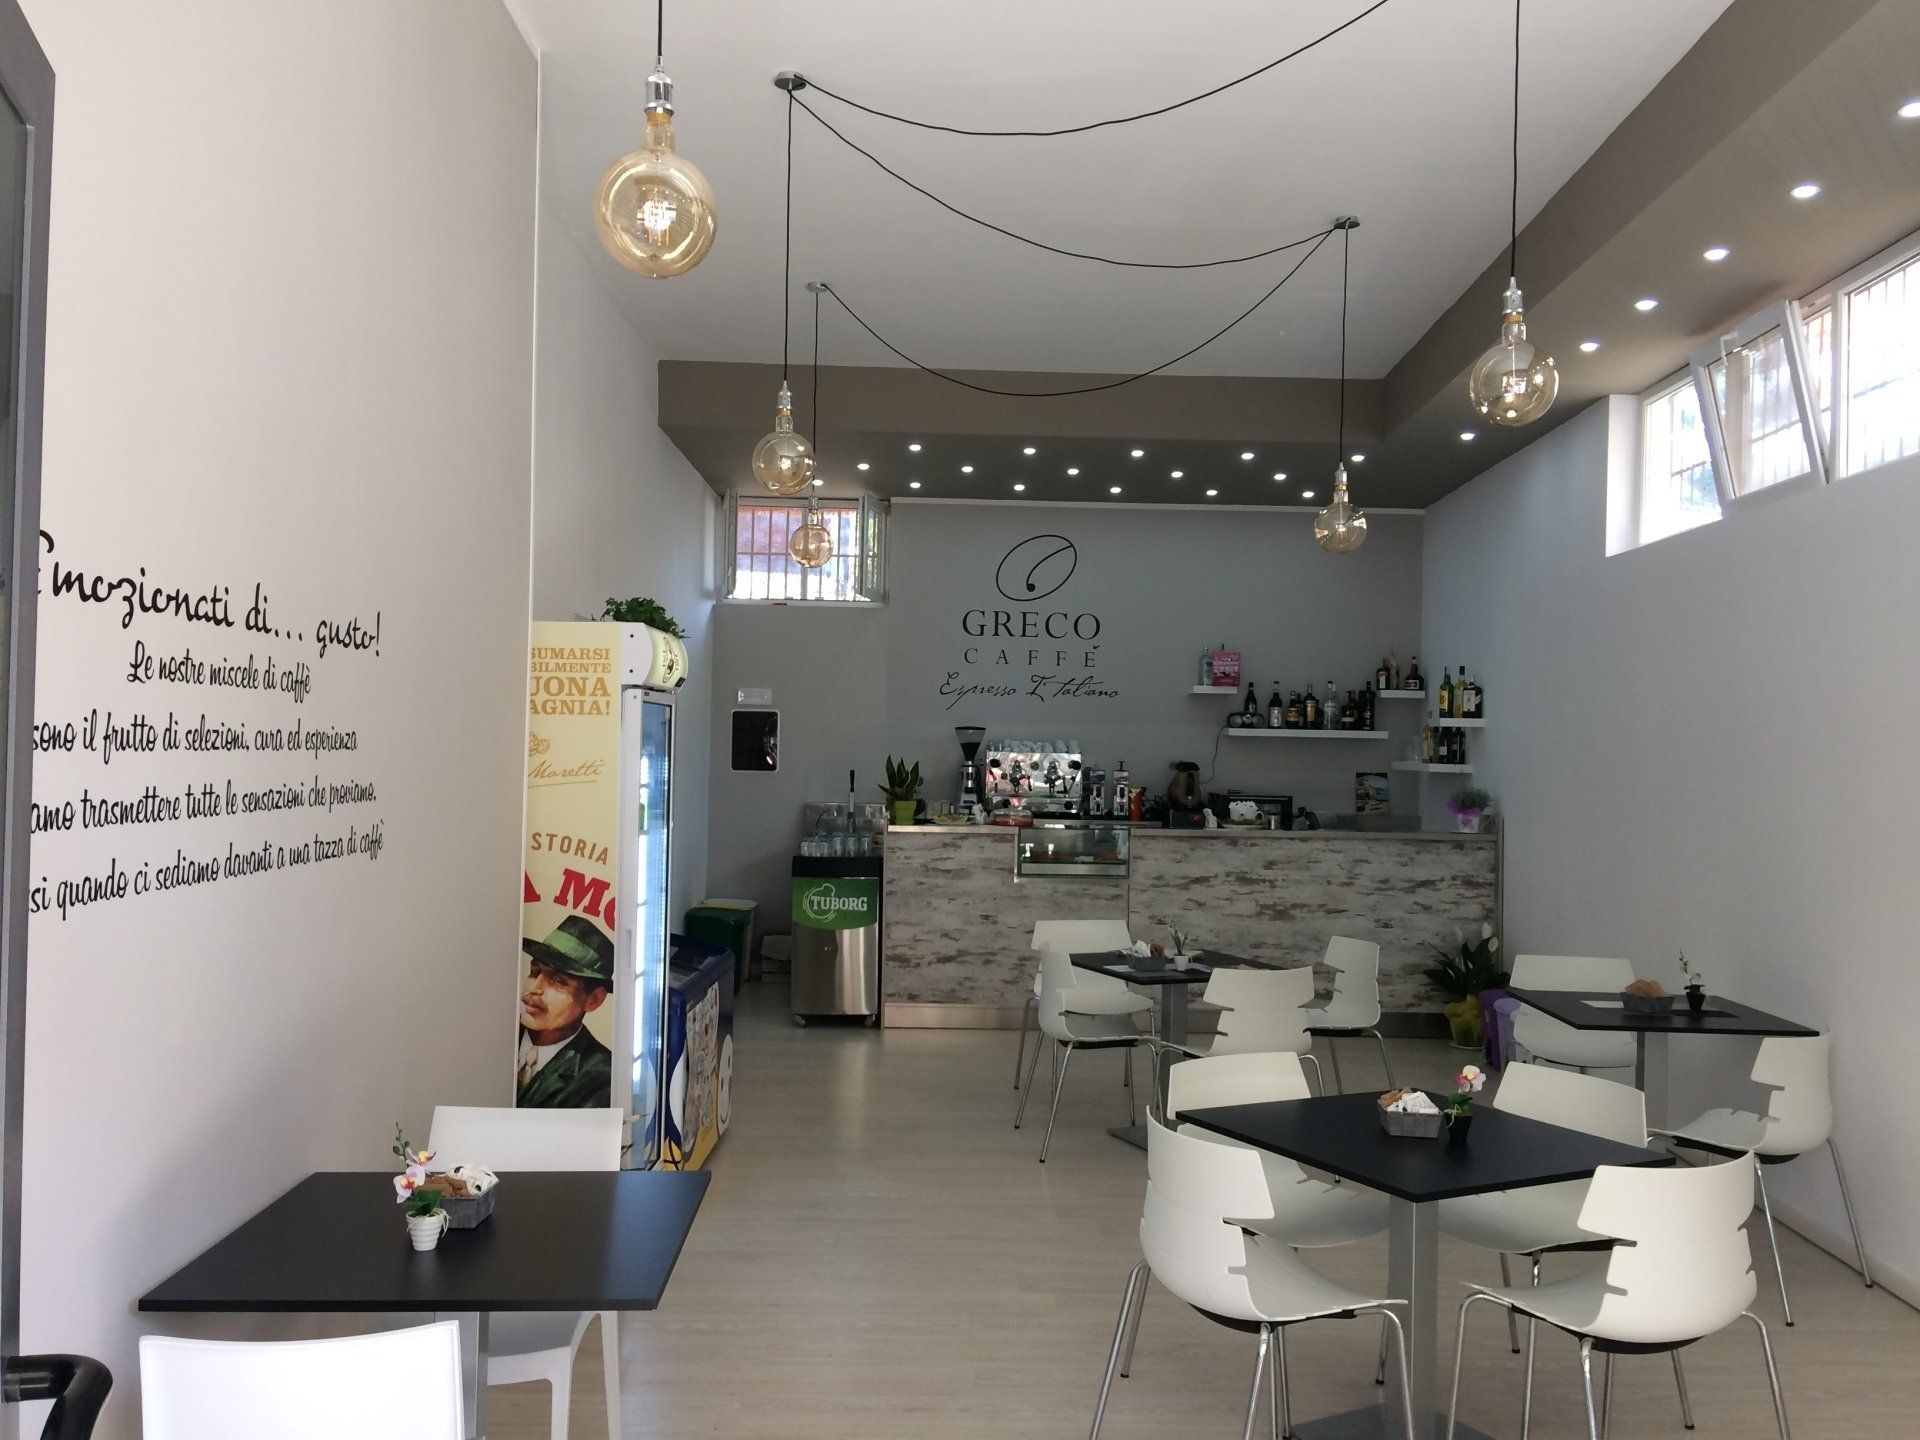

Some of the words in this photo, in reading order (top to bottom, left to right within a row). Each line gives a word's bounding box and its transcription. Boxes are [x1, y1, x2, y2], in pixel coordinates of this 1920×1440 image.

[316, 611, 381, 659] gusto!
[962, 609, 1101, 640] GRECO
[127, 640, 154, 684] Le
[158, 648, 206, 686] nostre
[209, 653, 260, 690] miscele
[263, 656, 277, 690] di
[280, 661, 312, 704] caffè
[939, 671, 1016, 711] Espresso
[1025, 674, 1120, 702] Italiano
[83, 708, 98, 752] il
[103, 712, 158, 766] frutto
[163, 712, 181, 752] di
[254, 729, 285, 752] cura
[287, 718, 303, 752] ed
[305, 726, 358, 760] esperienza
[528, 759, 606, 779] Moretti
[80, 786, 182, 829] trasmettere
[185, 782, 222, 819] tutte
[226, 779, 239, 815] le
[242, 782, 305, 813] sensazioni
[308, 775, 327, 808] che
[329, 780, 377, 814] proviamo.
[57, 858, 129, 921] quando
[134, 862, 151, 895] ci
[155, 849, 220, 890] sediamo
[224, 841, 274, 879] davanti
[277, 847, 286, 869] a
[289, 843, 311, 866] una
[313, 834, 344, 863] tazza
[347, 825, 357, 855] di
[359, 818, 385, 861] caffè
[531, 832, 609, 865] STORIA
[810, 895, 868, 911] TUBORG
